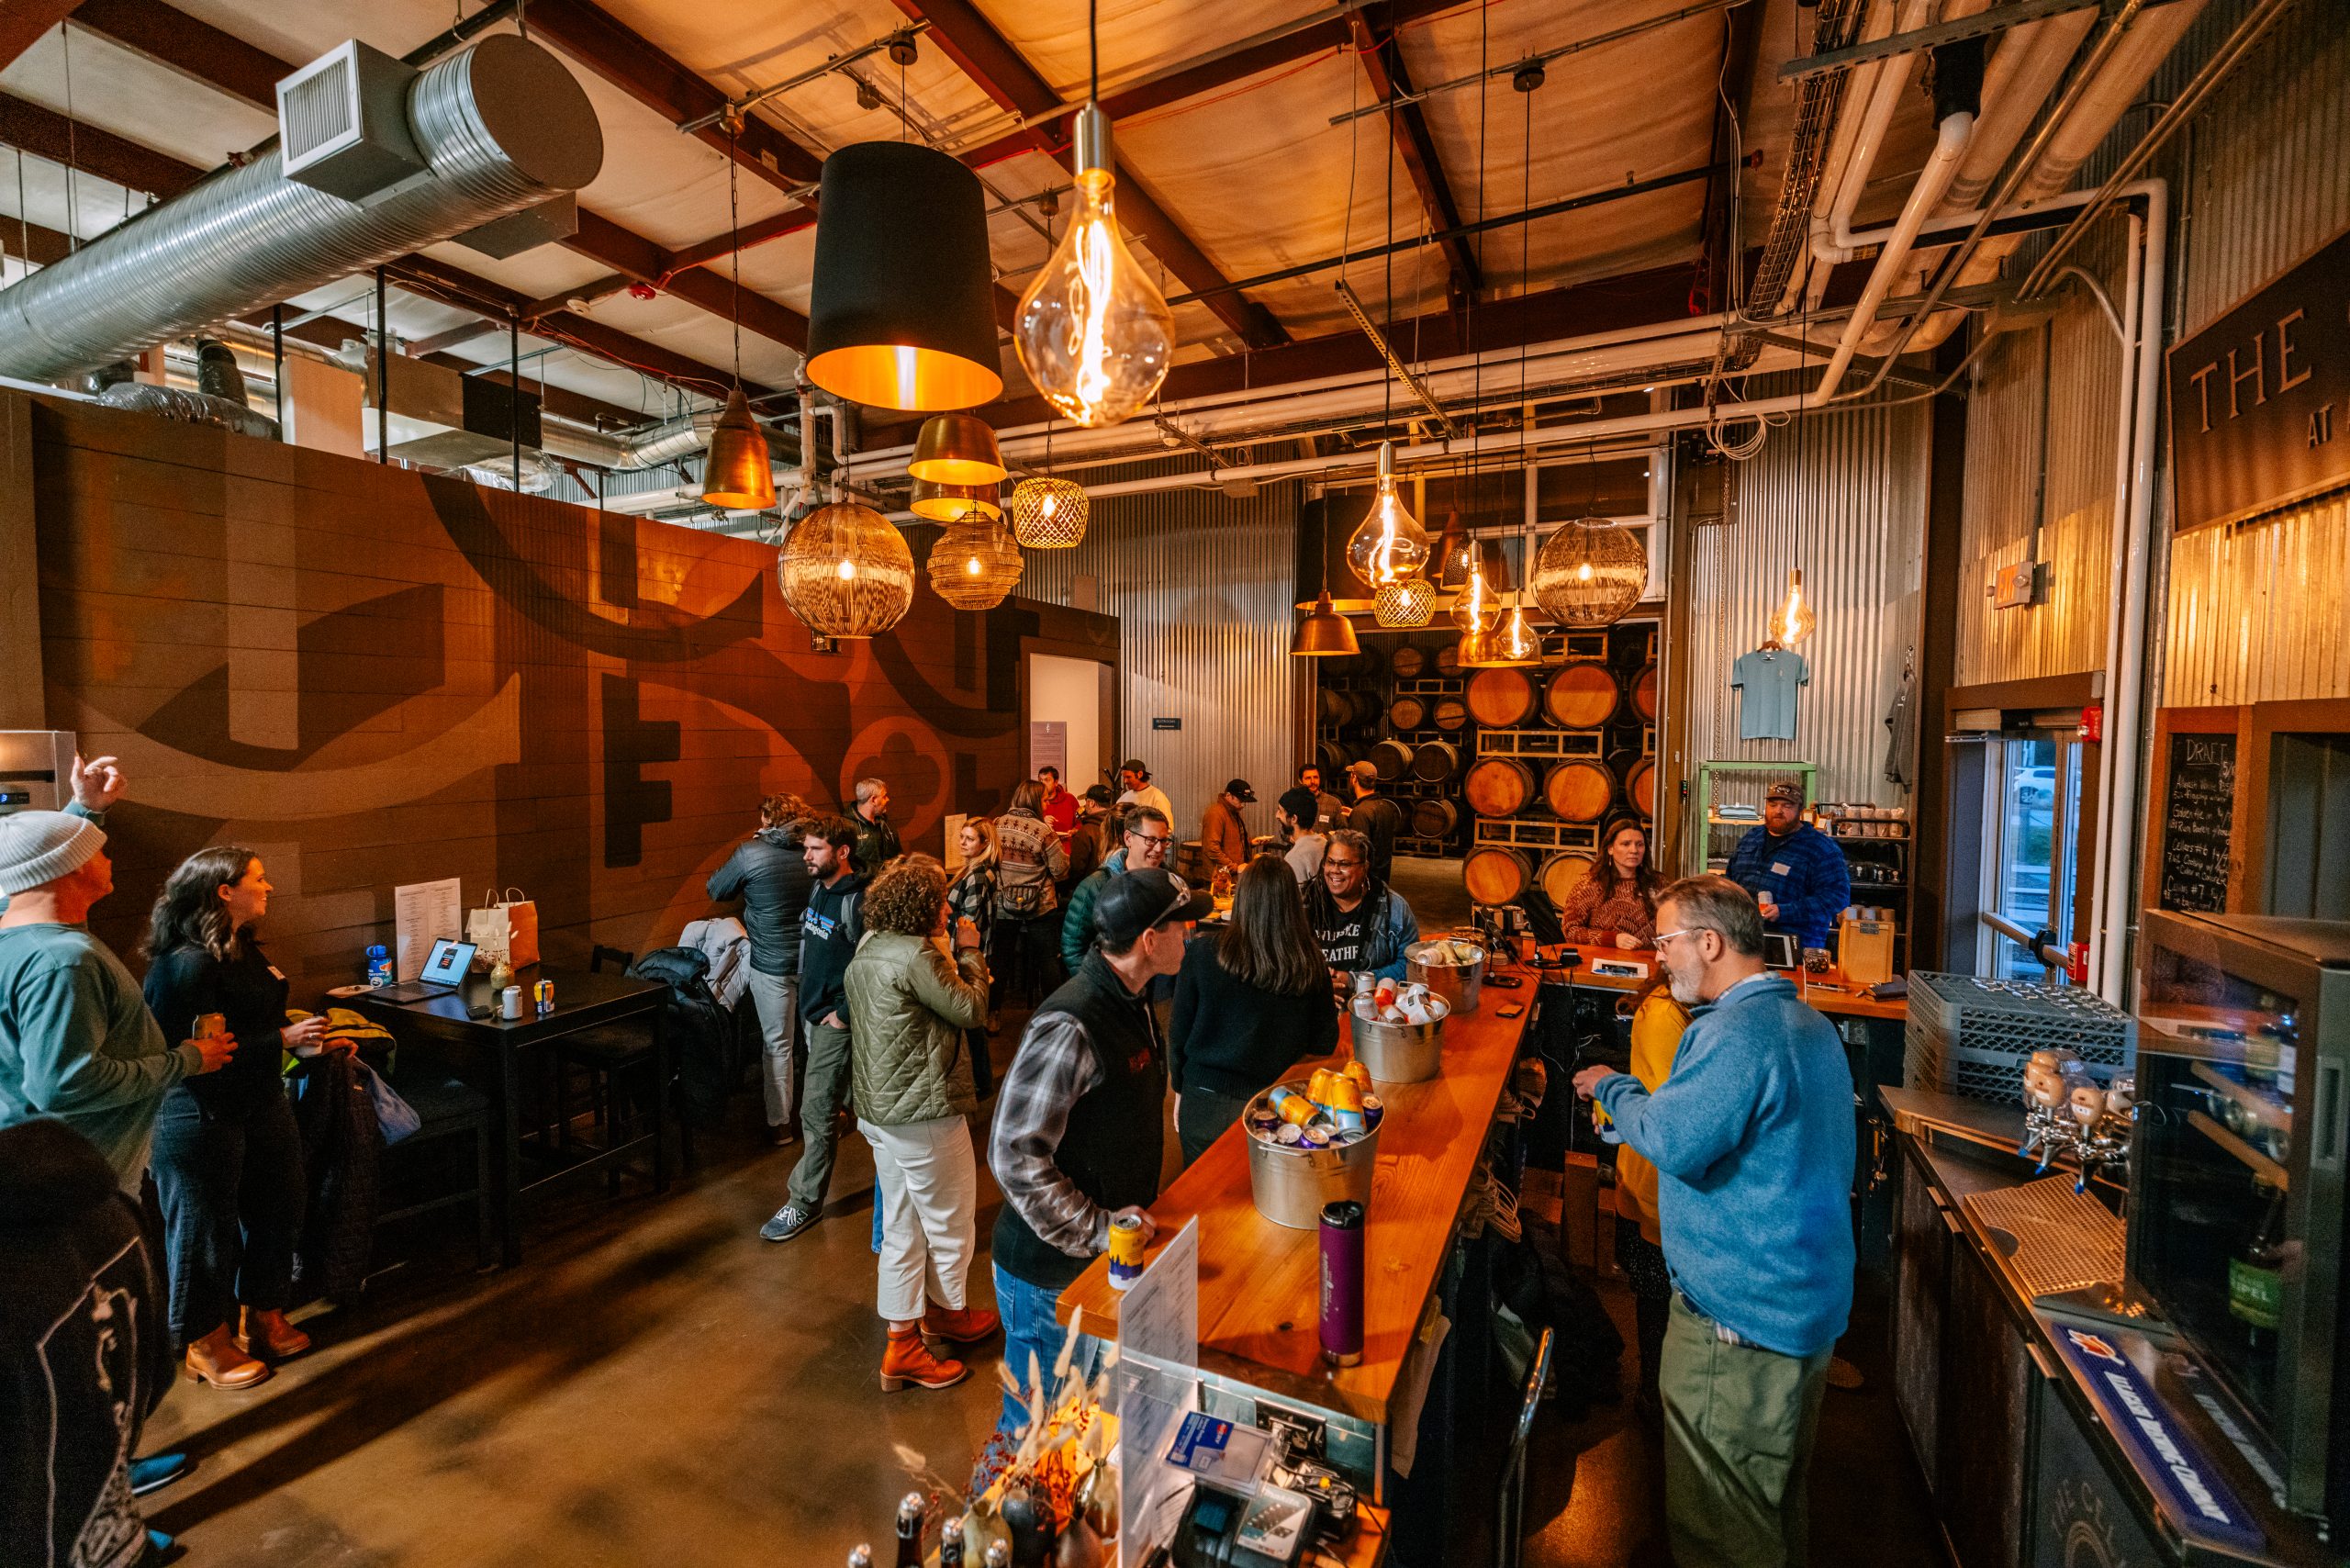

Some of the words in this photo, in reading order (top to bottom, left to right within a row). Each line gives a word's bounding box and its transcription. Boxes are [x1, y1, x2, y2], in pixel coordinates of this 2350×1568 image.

[2189, 308, 2312, 434] THE
[2307, 402, 2334, 449] AT
[2186, 738, 2228, 763] DRAFT
